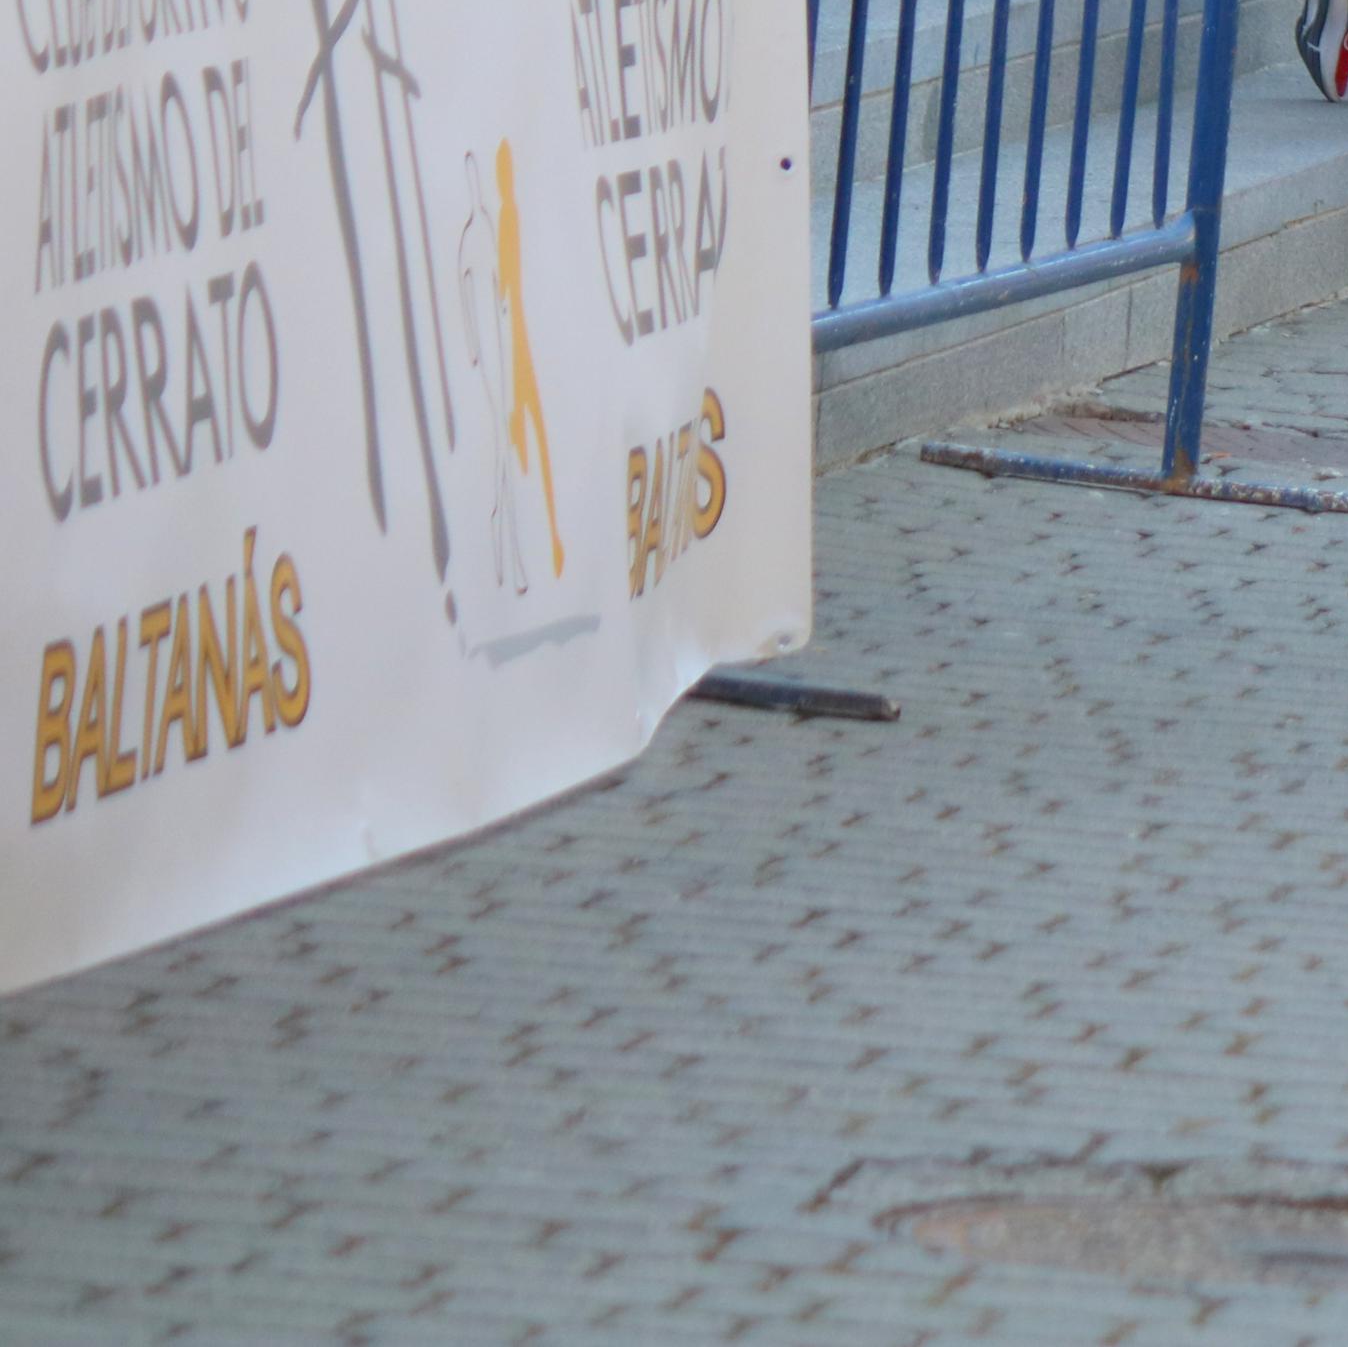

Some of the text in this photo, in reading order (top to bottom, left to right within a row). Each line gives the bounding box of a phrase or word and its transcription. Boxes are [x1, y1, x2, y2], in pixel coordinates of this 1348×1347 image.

[34, 56, 264, 295] ATLETISMO DEL
[37, 260, 279, 522] CERRATO
[30, 525, 312, 825] BALTANÁS
